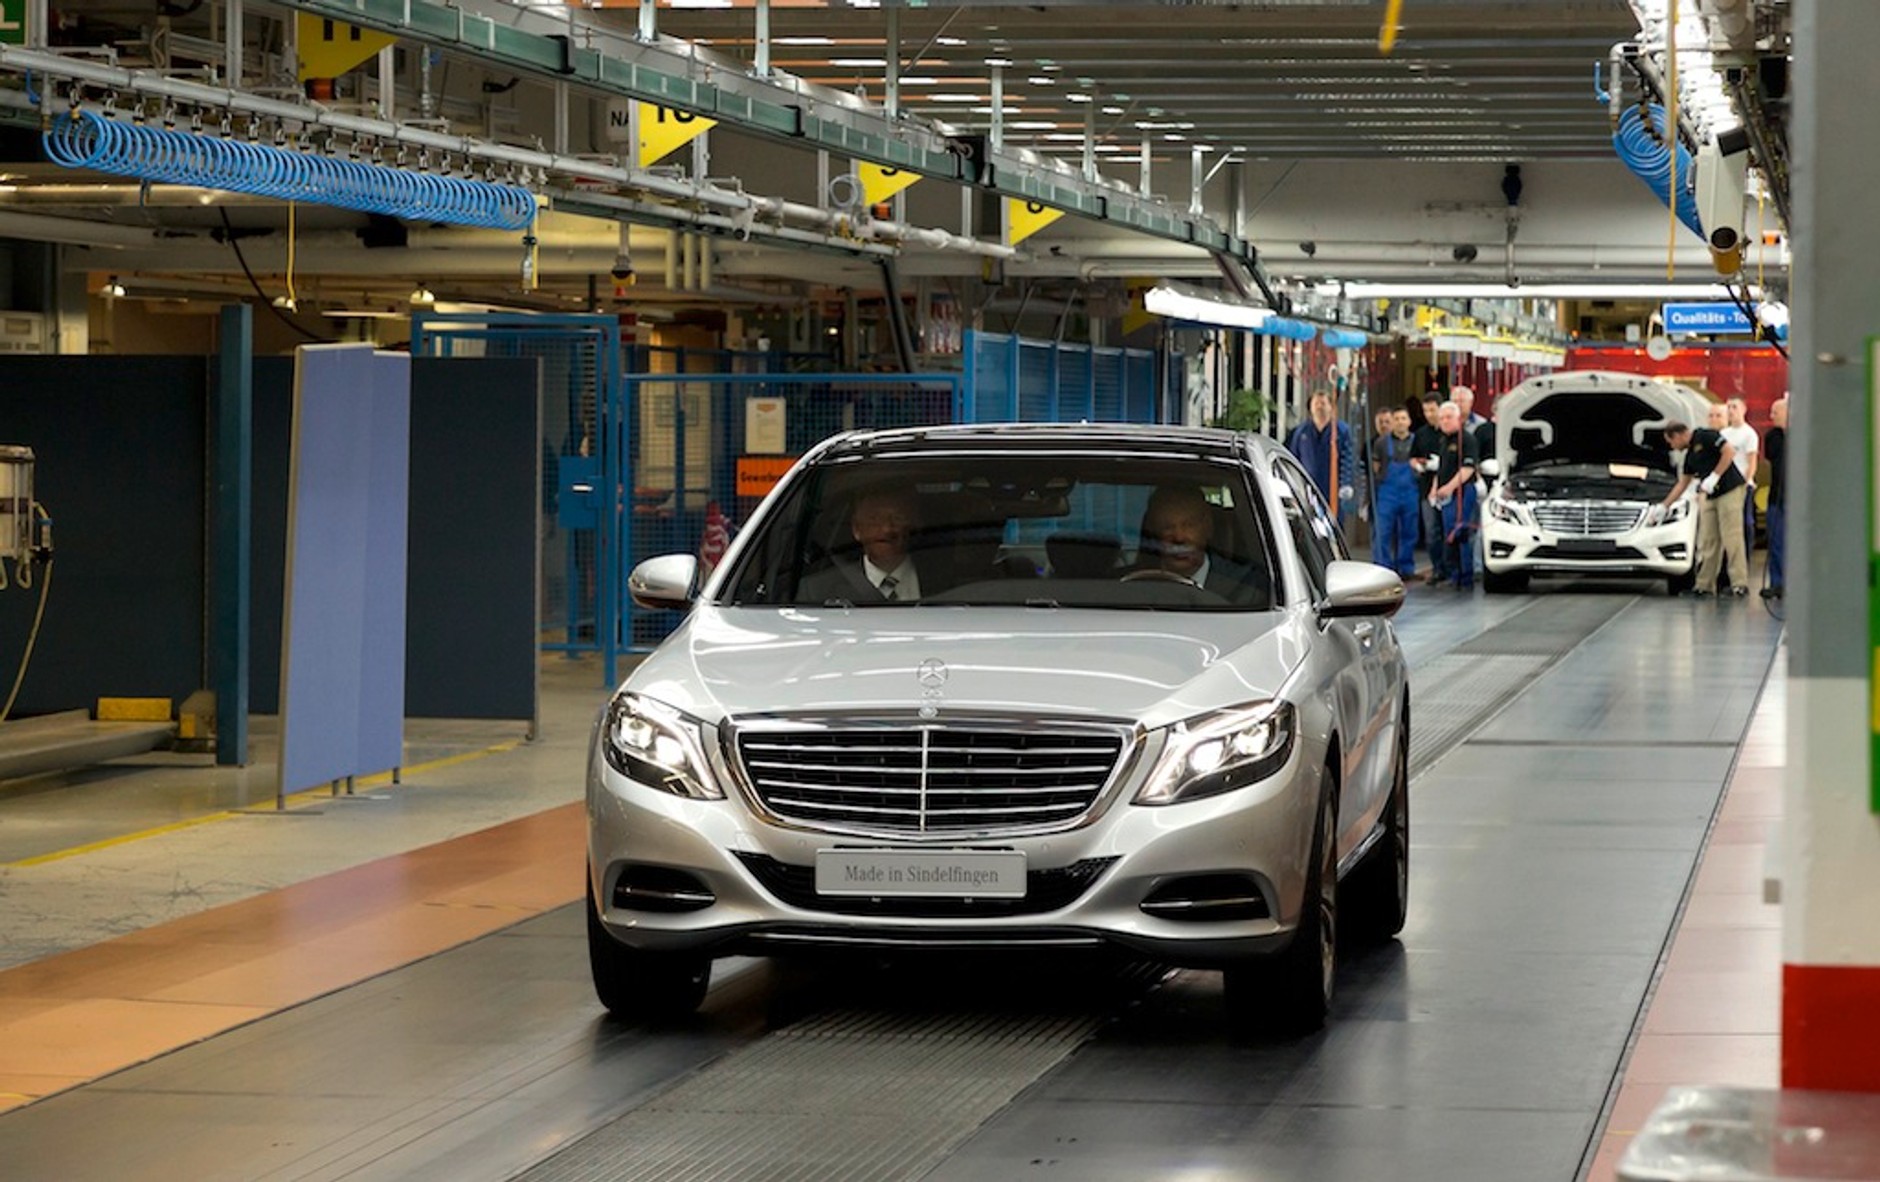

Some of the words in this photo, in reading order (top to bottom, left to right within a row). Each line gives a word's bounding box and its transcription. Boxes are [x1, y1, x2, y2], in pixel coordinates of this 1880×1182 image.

[844, 865, 884, 883] Made
[888, 866, 903, 883] in
[907, 865, 999, 886] Sindelfingen
